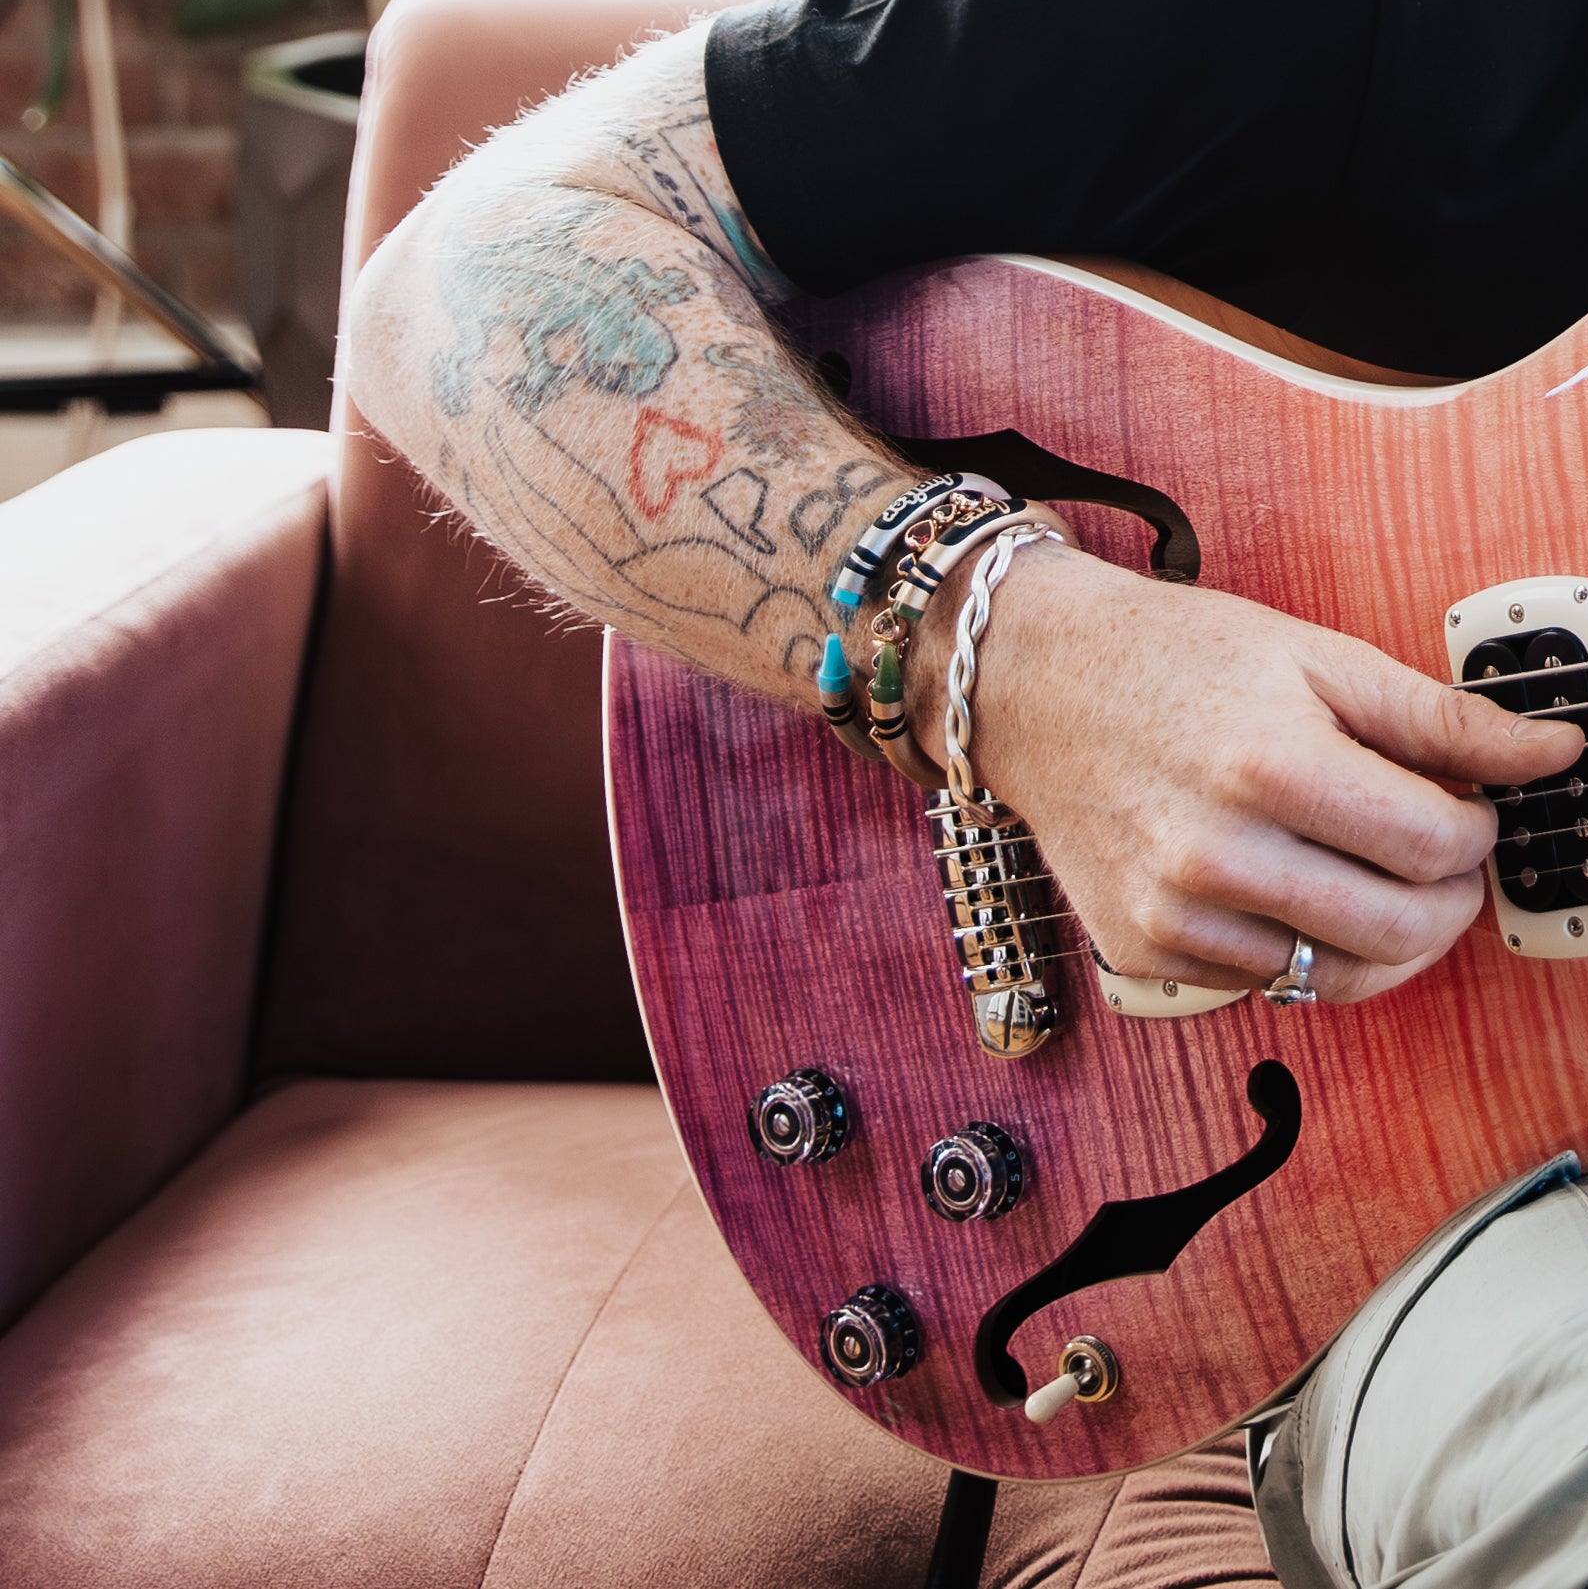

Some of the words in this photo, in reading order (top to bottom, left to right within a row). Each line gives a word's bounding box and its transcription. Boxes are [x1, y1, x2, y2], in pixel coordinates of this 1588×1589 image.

[883, 472, 955, 523] Jupiter
[1005, 1151, 1017, 1161] 6
[1010, 1173, 1020, 1182] 5
